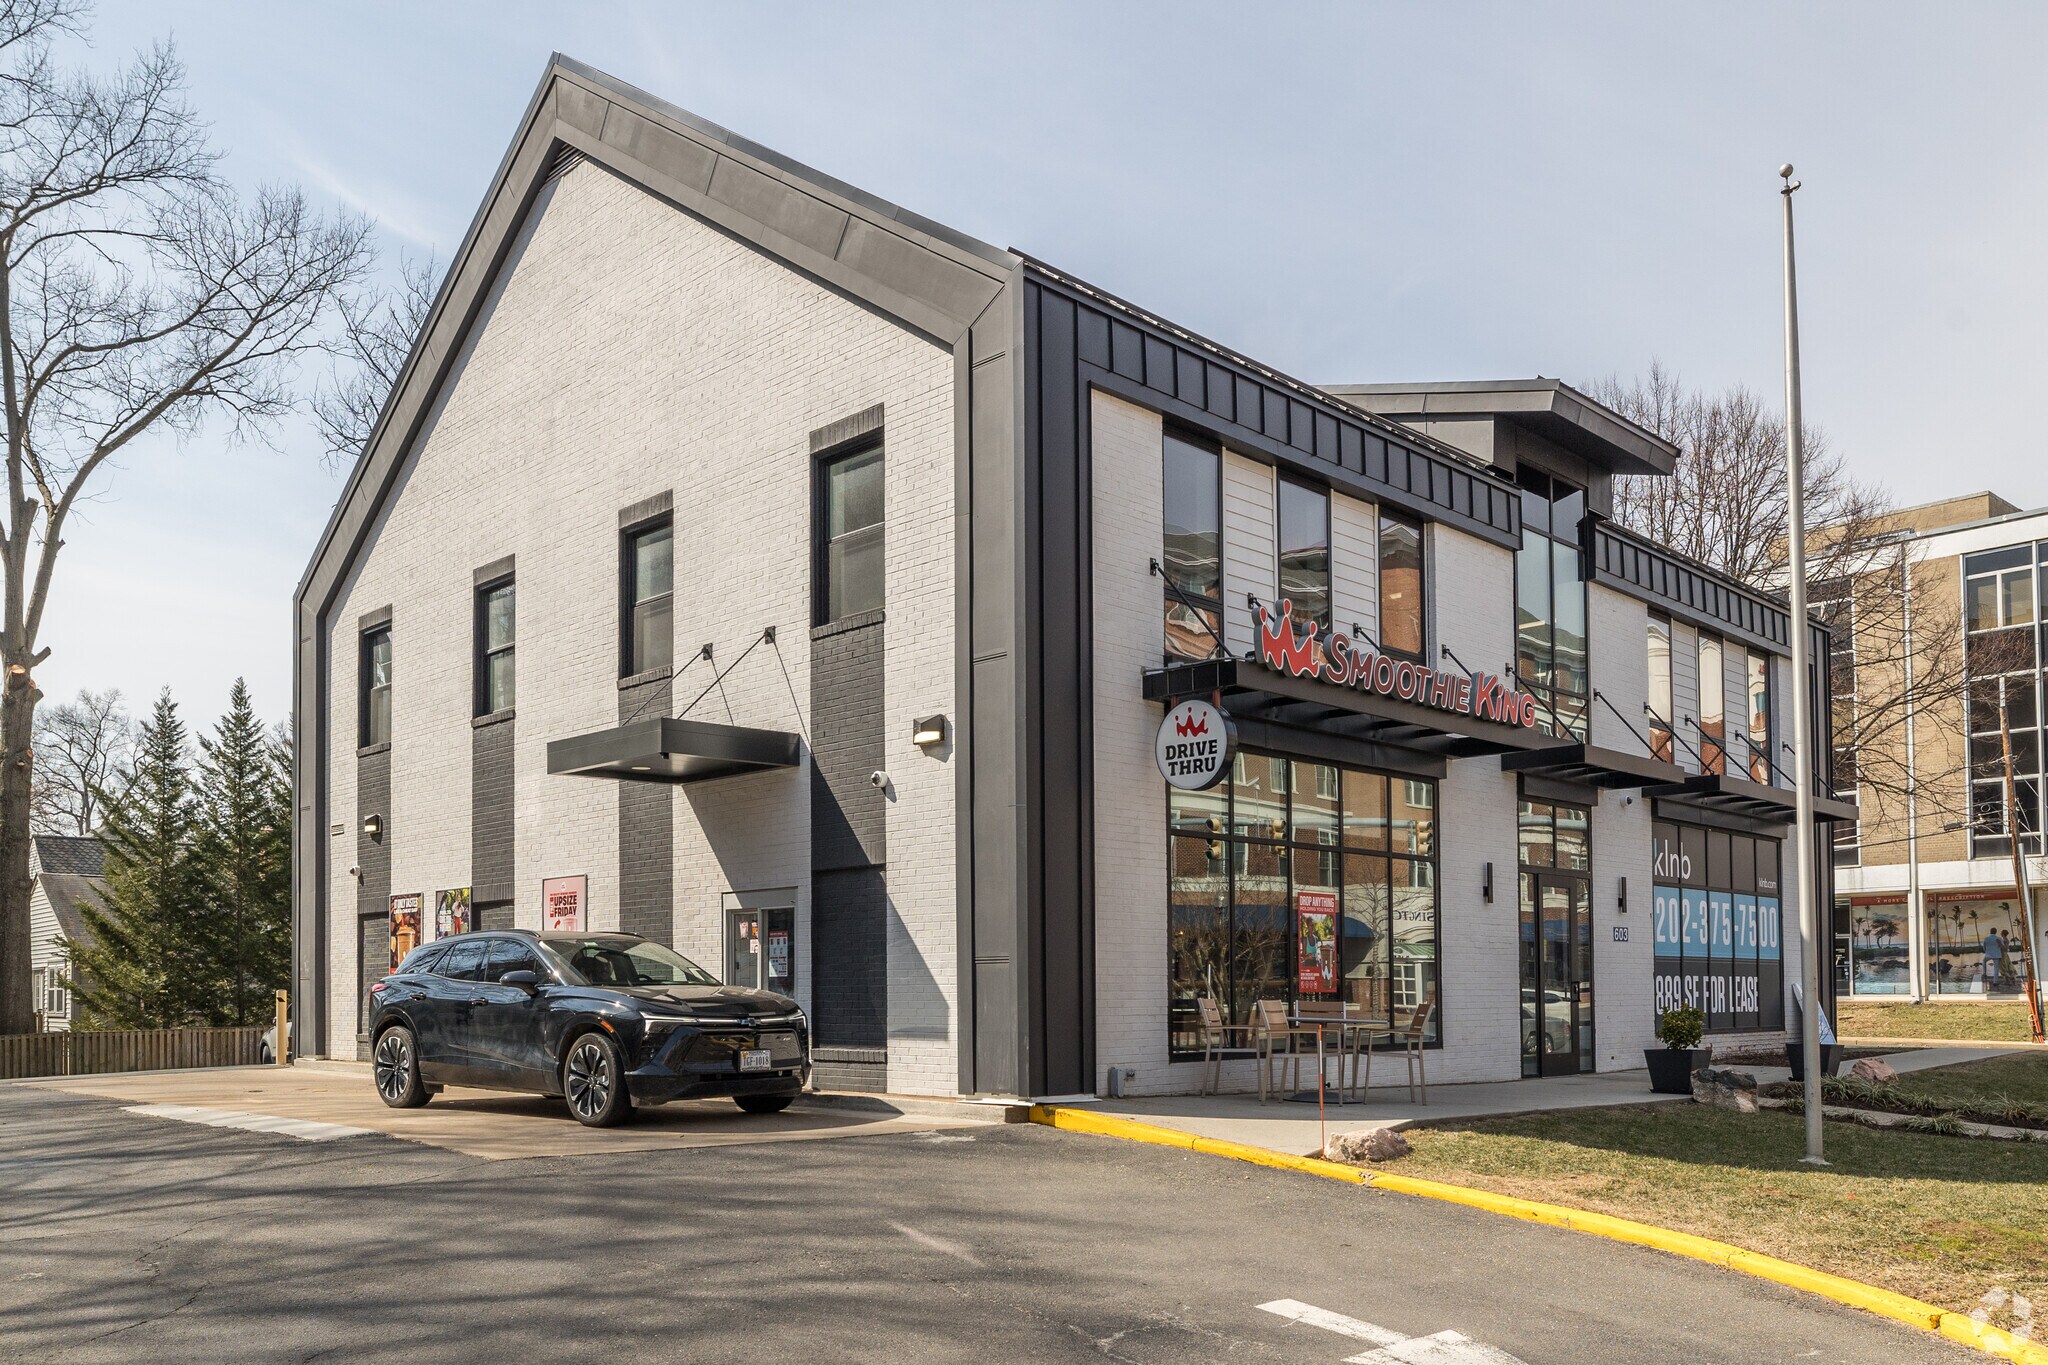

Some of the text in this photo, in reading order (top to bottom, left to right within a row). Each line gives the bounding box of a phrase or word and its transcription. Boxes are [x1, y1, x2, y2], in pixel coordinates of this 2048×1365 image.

[1325, 632, 1471, 714] SMOOTHIE
[1165, 739, 1218, 761] DRIVE
[1167, 756, 1216, 777] THRU
[1654, 838, 1691, 880] klnb
[554, 895, 577, 907] UPSIZE
[1300, 895, 1335, 908] DROP ANYTHING
[554, 906, 577, 918] FRIDAY
[1656, 897, 1777, 948] 202-375-7500
[1614, 928, 1628, 942] 603
[1656, 975, 1758, 1015] 889 SF FOR LEASE
